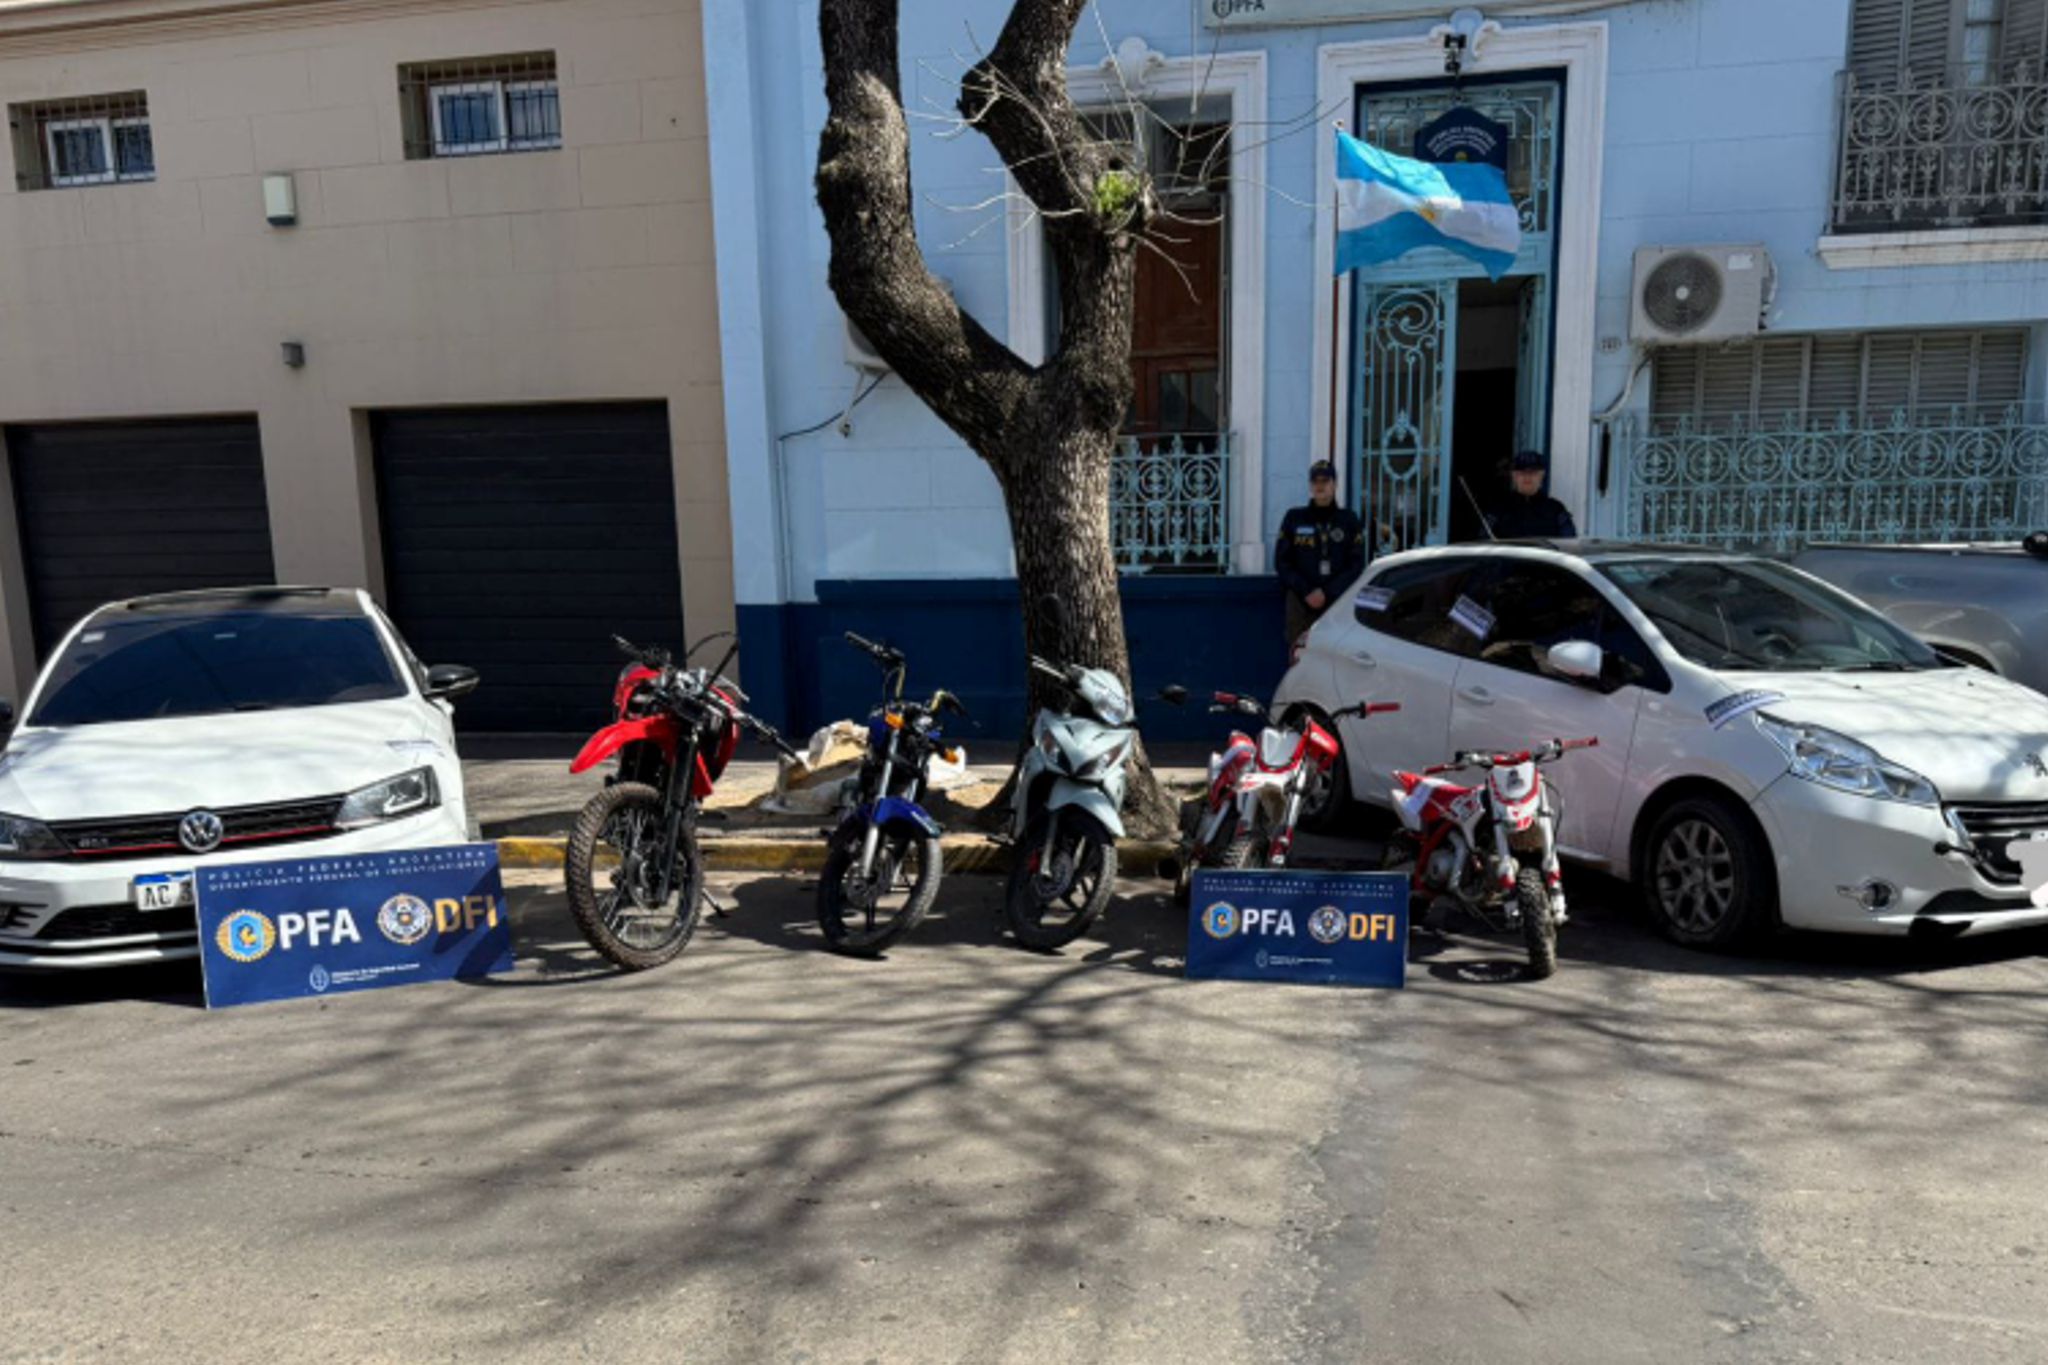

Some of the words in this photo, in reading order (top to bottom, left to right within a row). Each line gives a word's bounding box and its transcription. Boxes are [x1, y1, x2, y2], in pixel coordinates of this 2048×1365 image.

[278, 908, 362, 950] PFA
[433, 895, 499, 934] DFI
[1241, 908, 1295, 937] PFA
[1348, 913, 1396, 942] DFI
